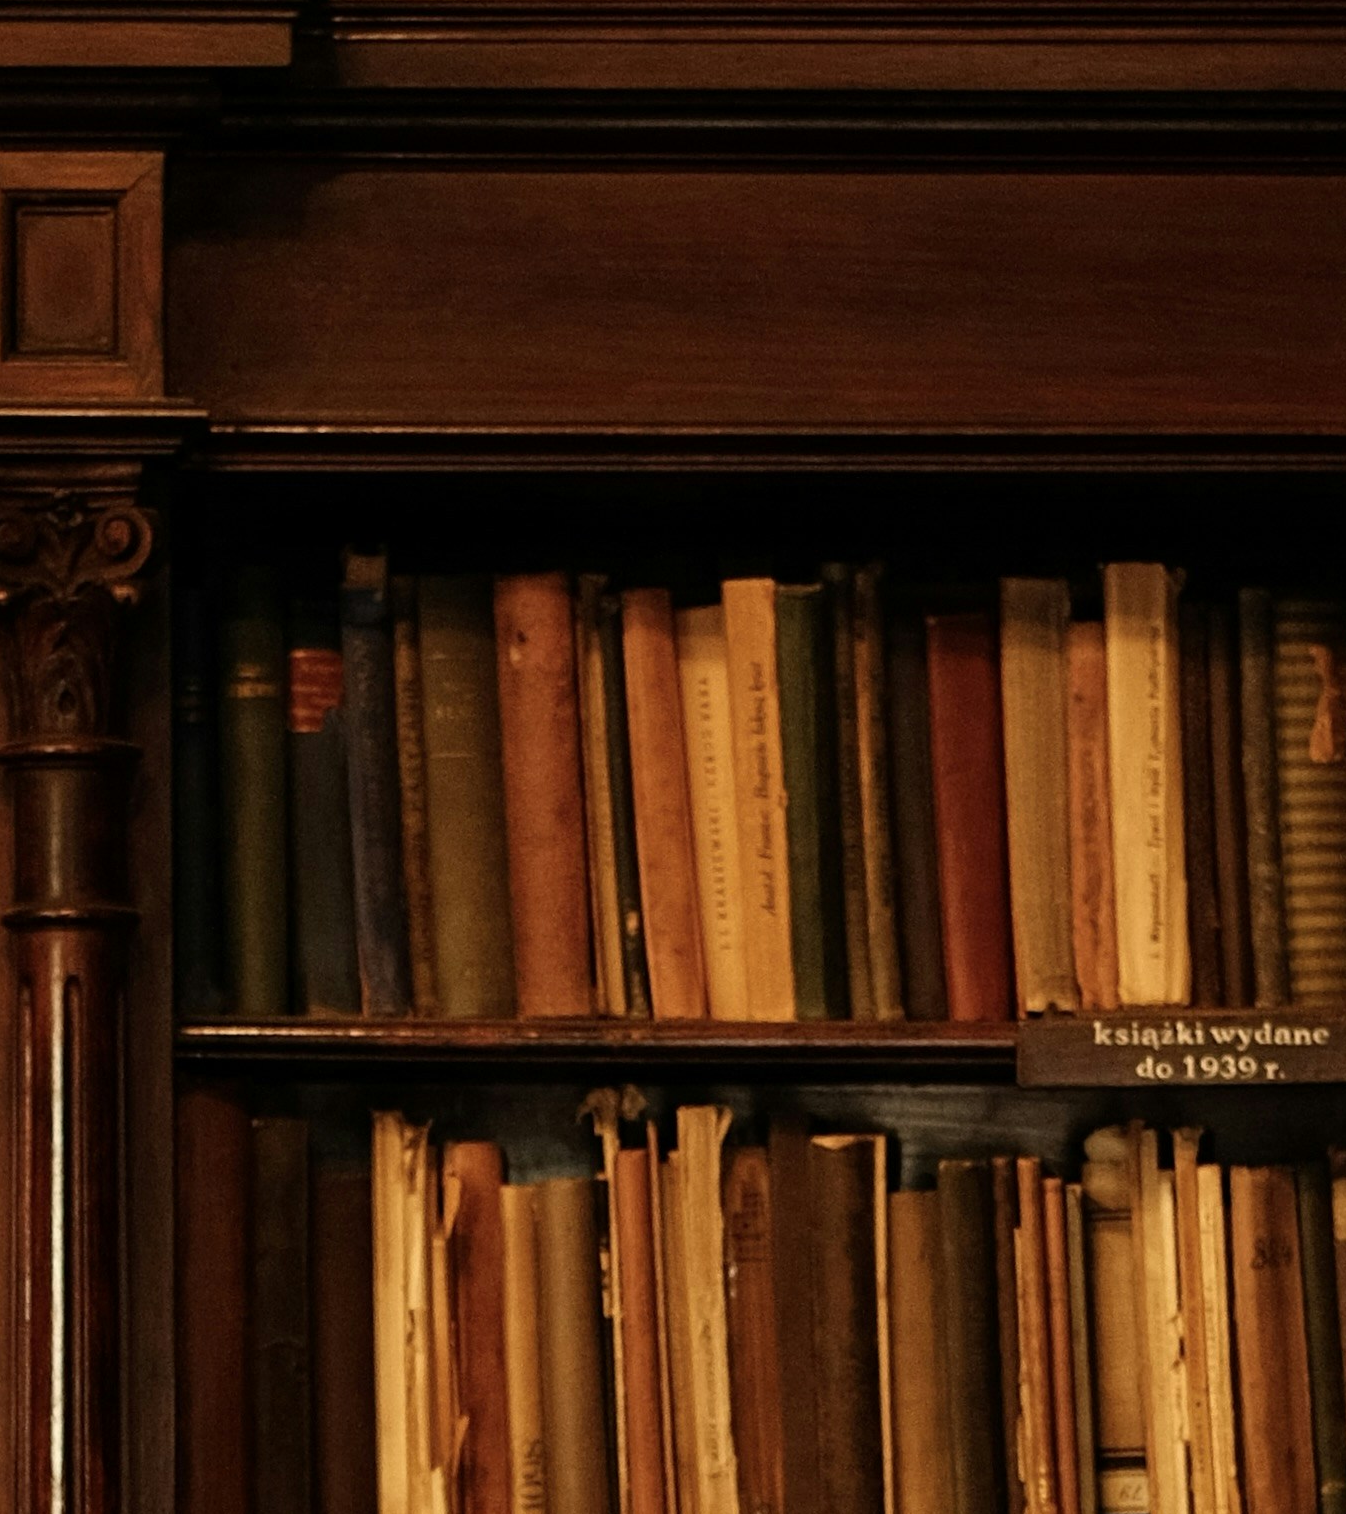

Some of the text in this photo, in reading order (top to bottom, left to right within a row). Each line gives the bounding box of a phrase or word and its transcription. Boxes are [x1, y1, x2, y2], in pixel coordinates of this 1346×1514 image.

[1092, 1020, 1331, 1053] książki wydane
[1135, 1055, 1286, 1081] do 1939 r.
